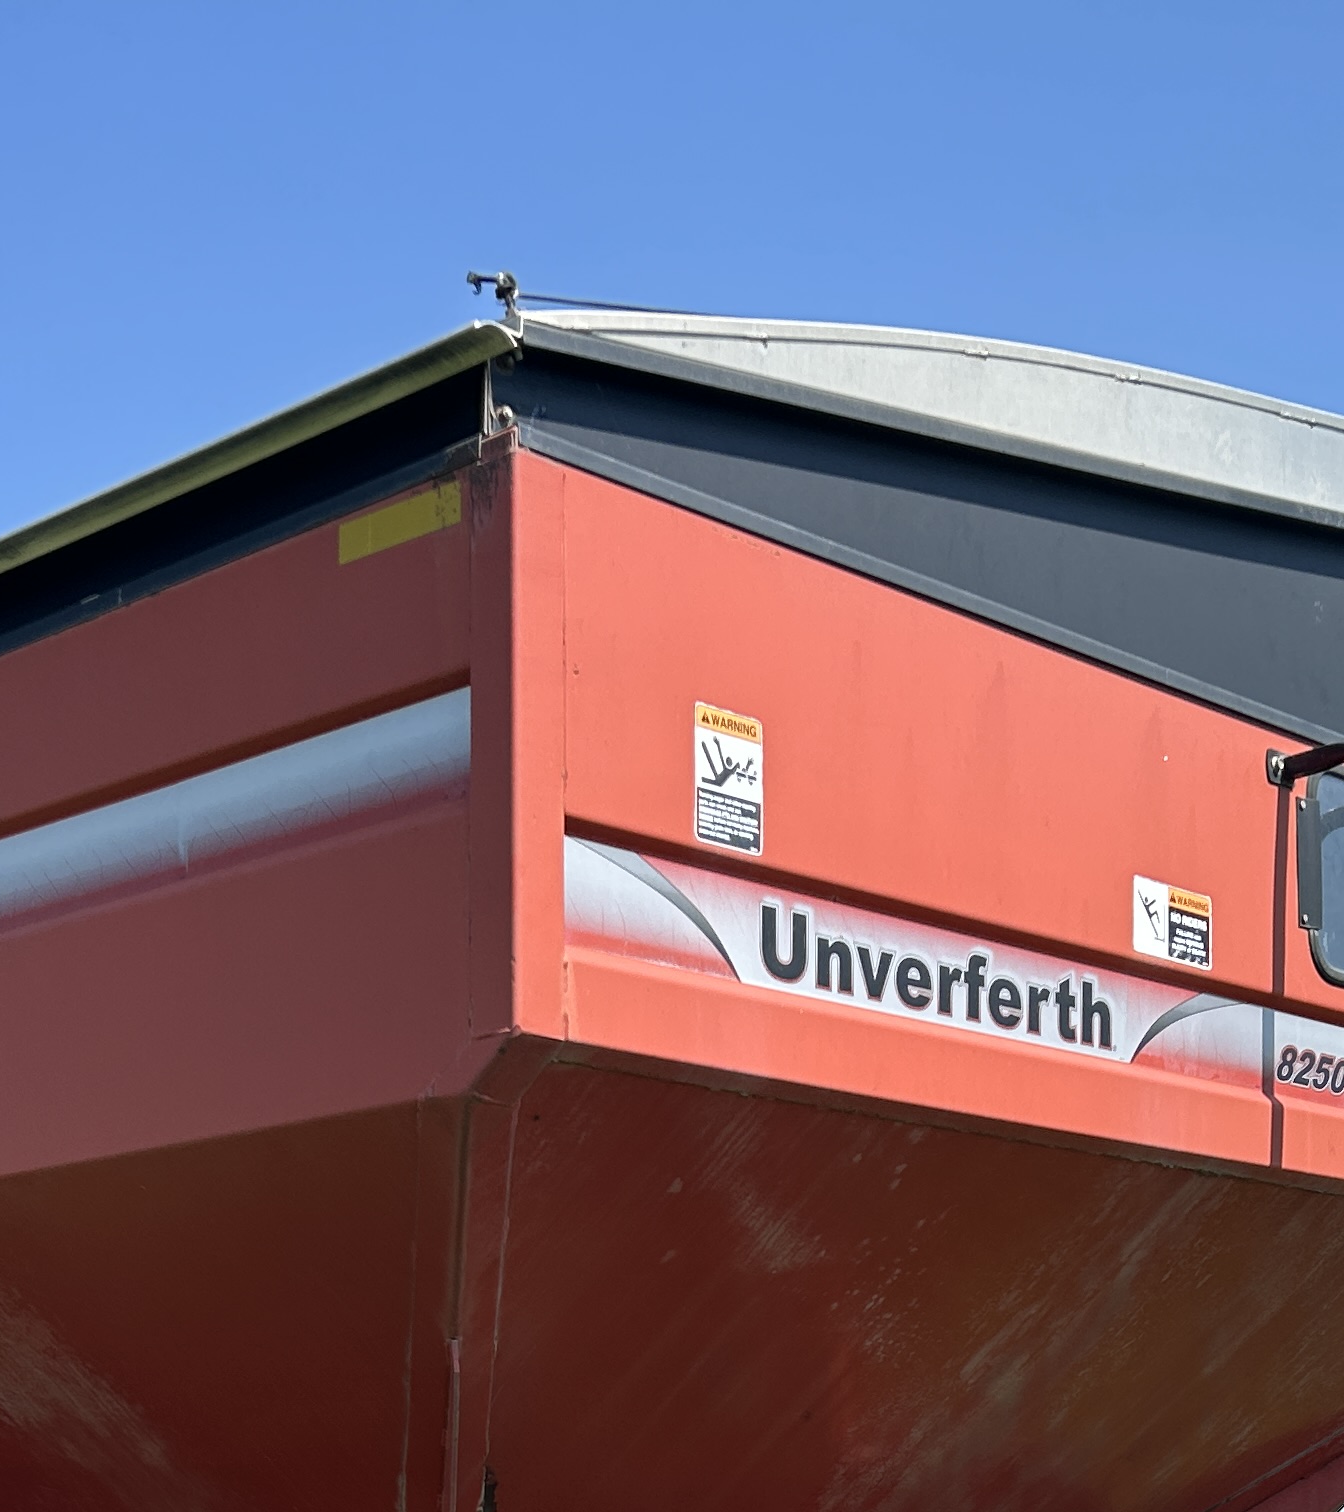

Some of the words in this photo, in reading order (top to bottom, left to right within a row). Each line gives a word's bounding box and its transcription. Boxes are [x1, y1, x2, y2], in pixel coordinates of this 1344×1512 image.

[711, 713, 757, 738] WARNING
[1176, 895, 1209, 913] WARNING
[760, 903, 1113, 1050] Unverferth
